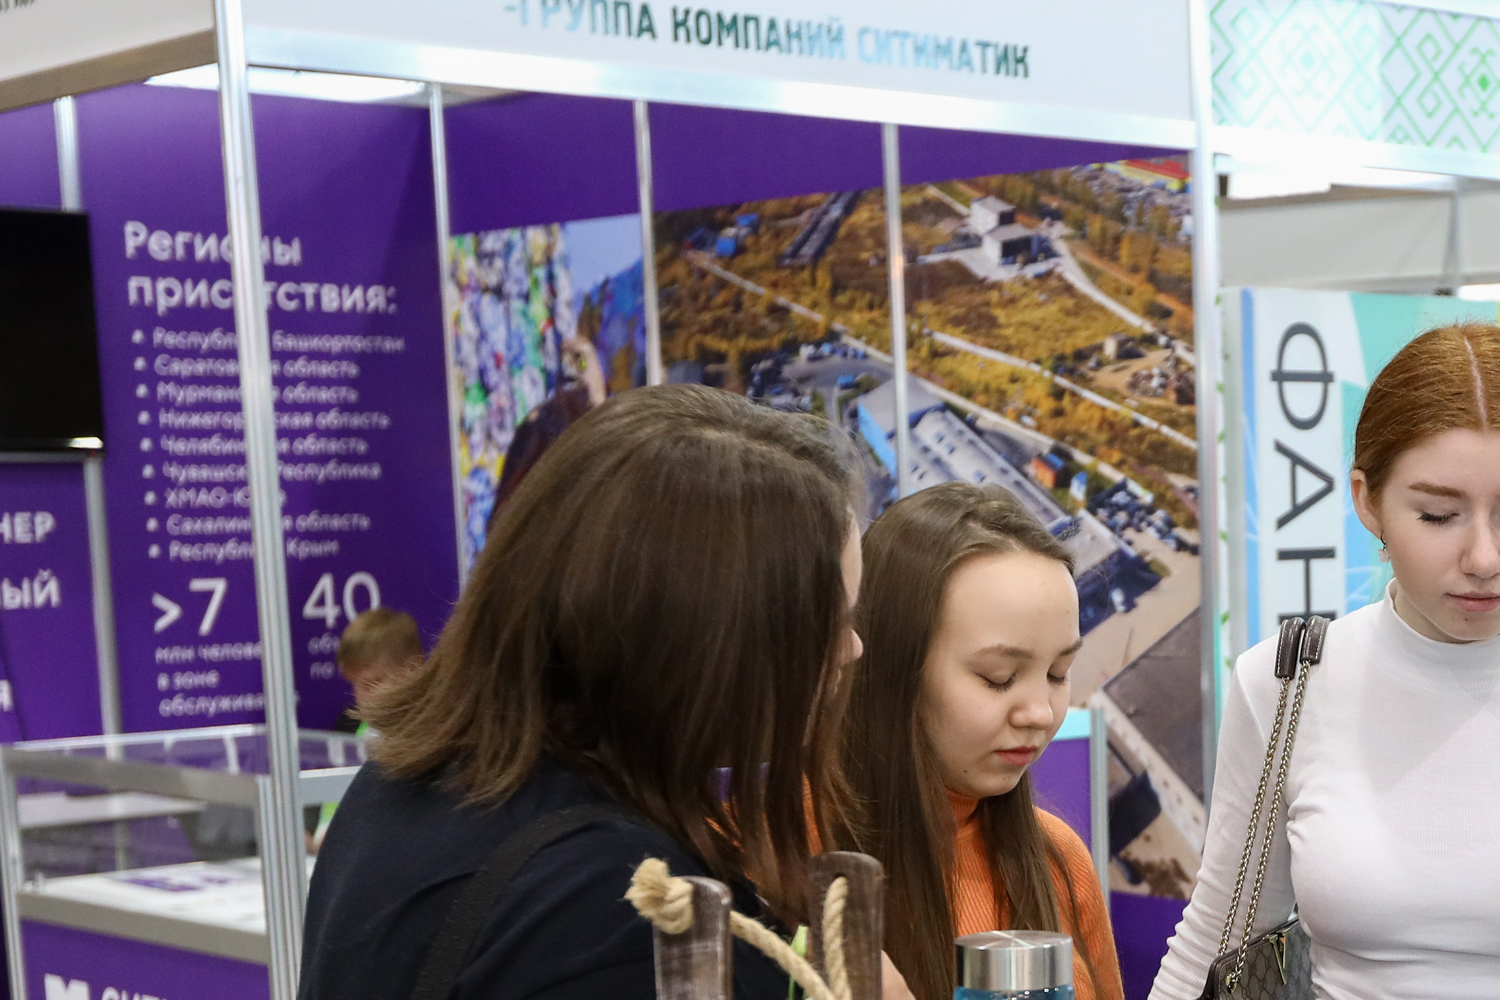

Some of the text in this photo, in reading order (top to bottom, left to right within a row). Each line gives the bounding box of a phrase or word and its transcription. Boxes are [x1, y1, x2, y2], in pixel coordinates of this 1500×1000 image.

[671, 5, 847, 59] КОМПАНИЙ
[857, 26, 1030, 79] СИТИМАТИК
[272, 329, 406, 355] Башкортостан
[283, 355, 360, 378] область
[283, 381, 359, 404] область
[316, 407, 391, 430] область
[292, 433, 368, 456] область
[295, 509, 371, 532] область
[286, 536, 339, 560] Крым
[303, 571, 380, 628] 40
[155, 642, 263, 664] млн челове
[172, 669, 219, 690] зоне
